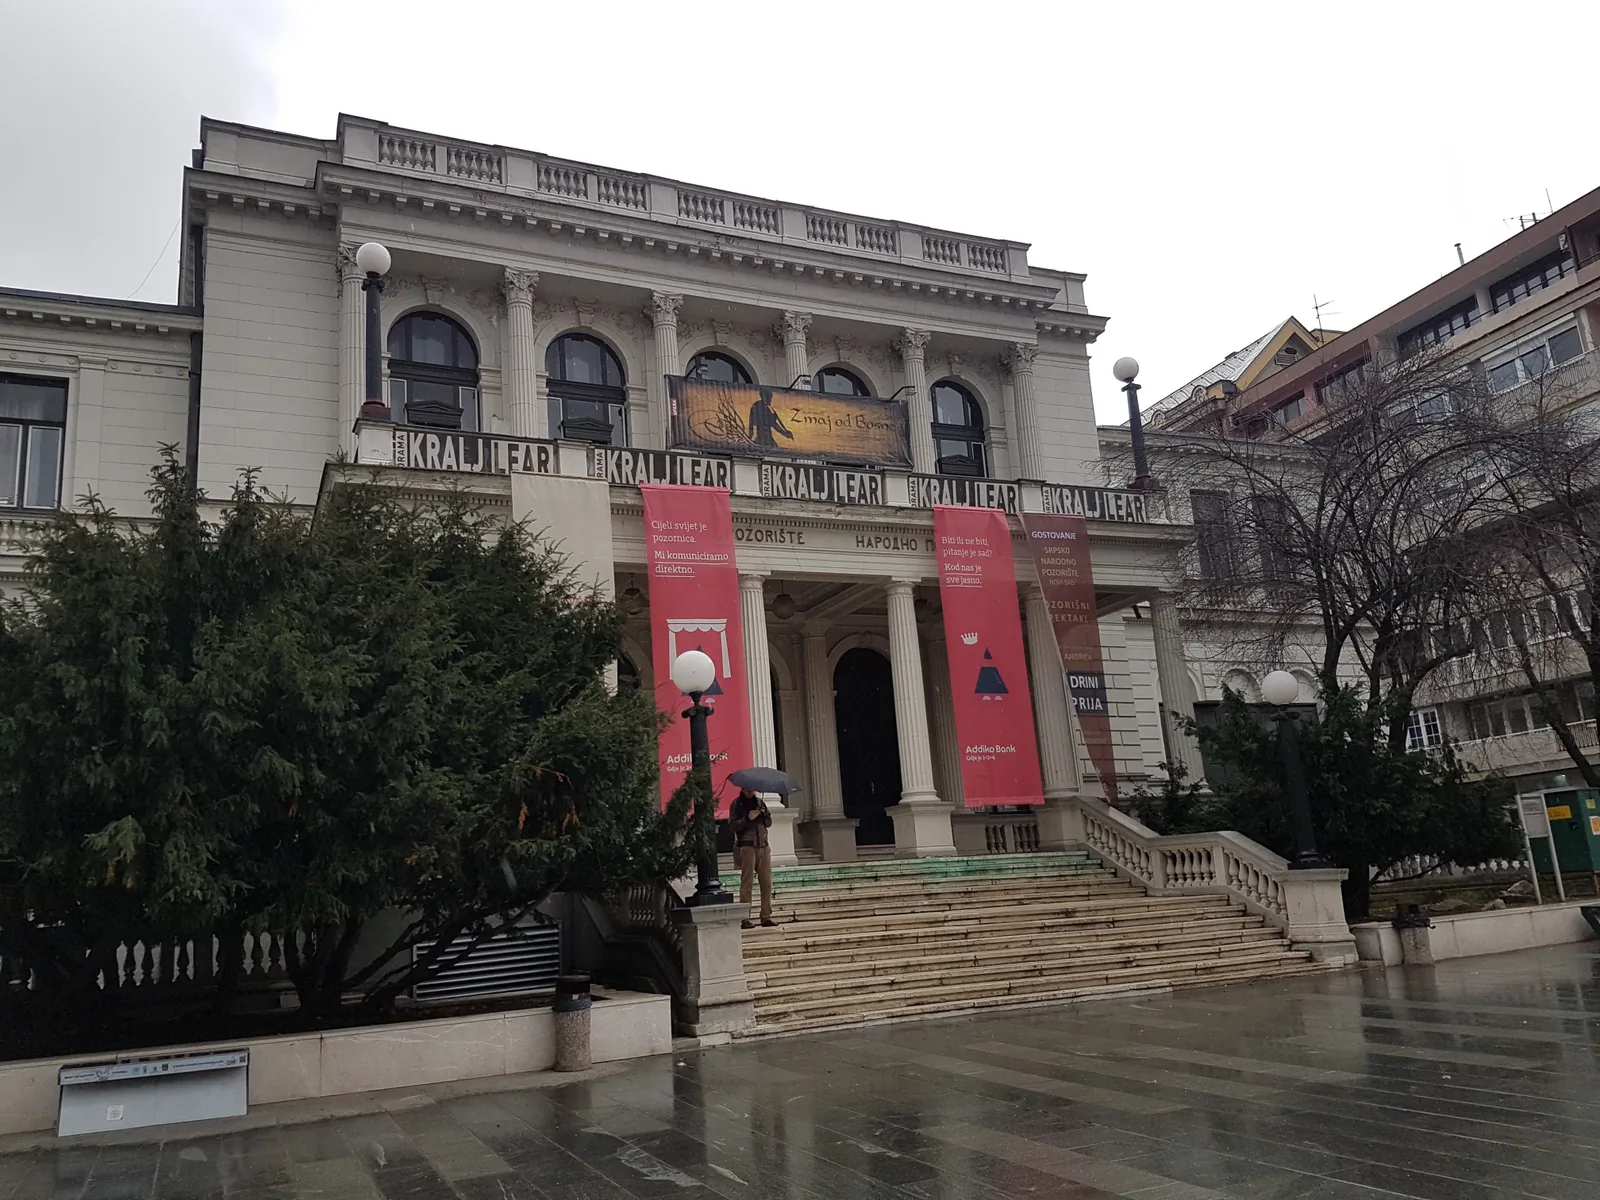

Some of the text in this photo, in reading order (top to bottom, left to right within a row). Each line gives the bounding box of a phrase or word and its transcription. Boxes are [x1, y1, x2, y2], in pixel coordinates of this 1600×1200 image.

[790, 407, 832, 433] Zmaj
[835, 413, 852, 427] od
[409, 431, 550, 474] KRALJ LEAR
[596, 451, 605, 478] RAMA
[607, 449, 728, 489] KRALJ LEAR
[772, 464, 879, 505] KRALJ LEAR
[919, 477, 1018, 514] KRALJ LEAR
[1051, 487, 1146, 522] KRALJ LEAR
[652, 520, 707, 533] Cijeli svijet je
[653, 534, 697, 544] pozornica.
[732, 528, 806, 545] OZORIŠTE
[941, 536, 956, 545] Biti
[956, 536, 964, 545] ili
[1031, 531, 1077, 540] GOSTOVANJE
[855, 535, 918, 551] НАРОДНО
[654, 550, 729, 561] Mi komuniciramo
[942, 549, 993, 558] pitanje je sad?
[1040, 558, 1077, 566] NARODNO
[655, 564, 695, 574] direktno.
[944, 563, 982, 574] Kod nas je
[1041, 567, 1079, 577] POZORIŠTE
[946, 576, 982, 585] sve jasno.
[1045, 599, 1090, 610] OZORIŠNI
[1049, 613, 1089, 623] PEKTAKL
[1069, 675, 1099, 689] DRINI
[1072, 697, 1103, 711] PRIJA
[966, 744, 1016, 753] Addiko Bank
[667, 753, 692, 764] Addi
